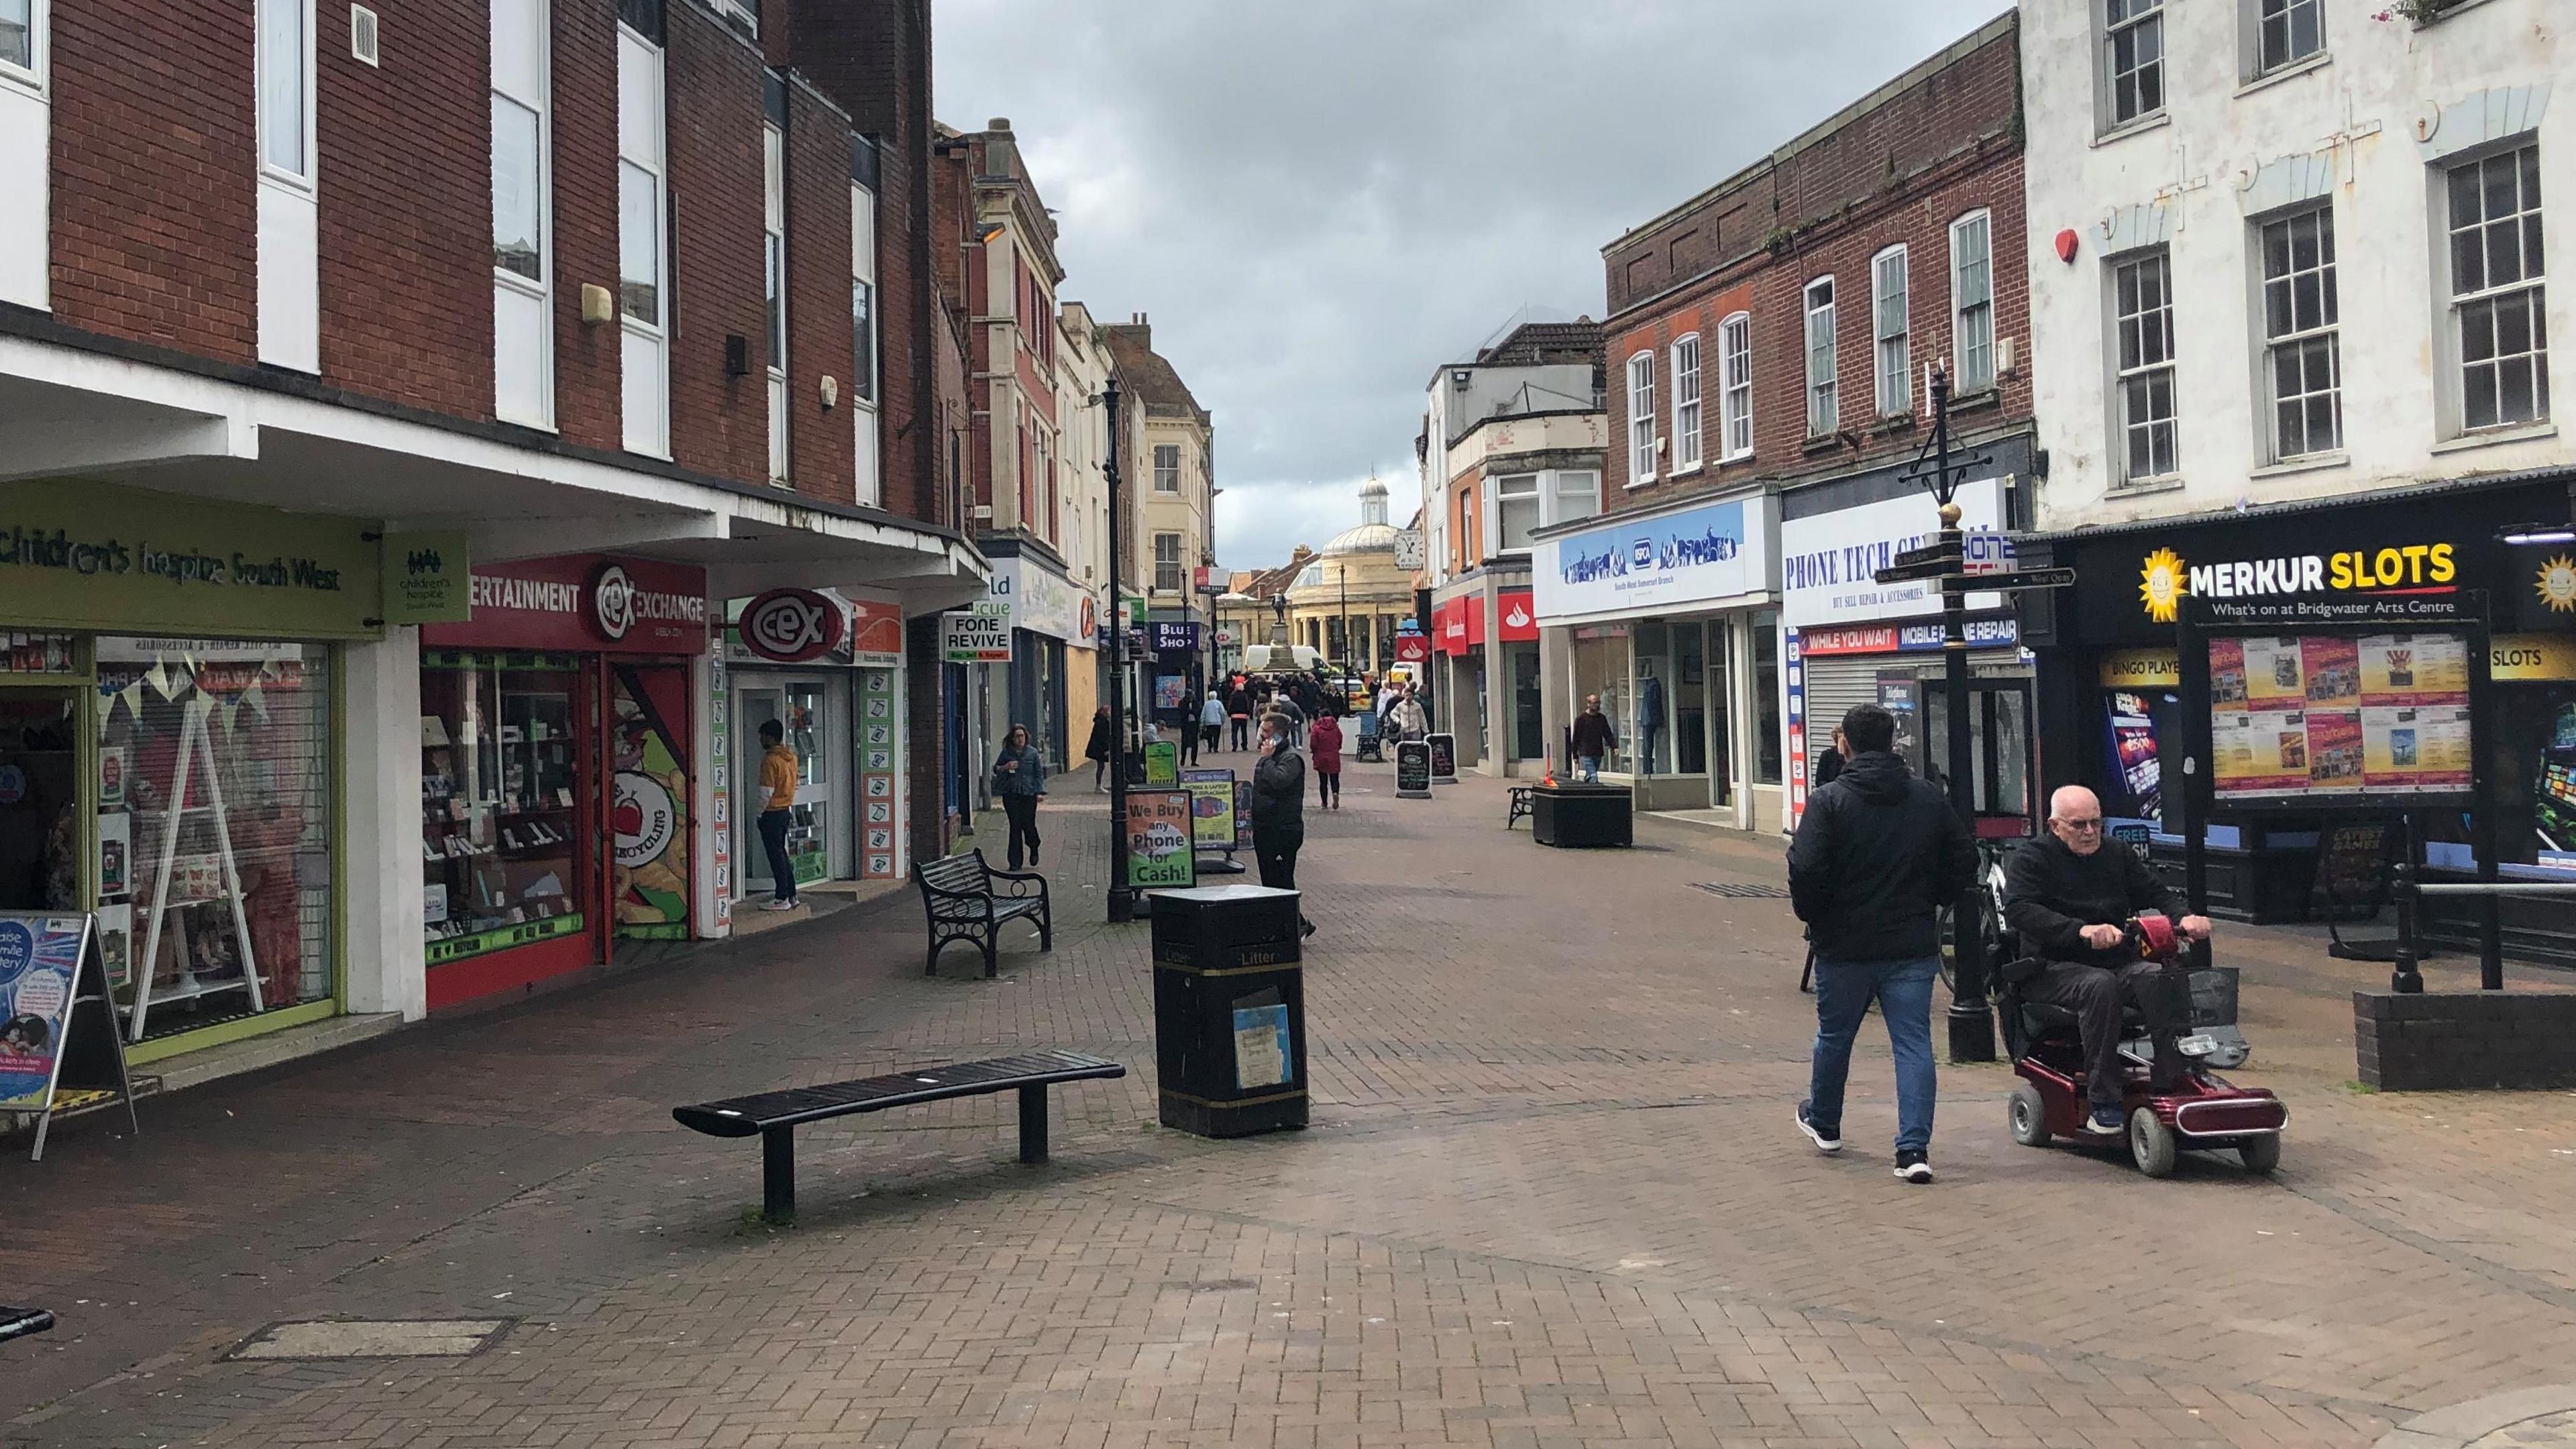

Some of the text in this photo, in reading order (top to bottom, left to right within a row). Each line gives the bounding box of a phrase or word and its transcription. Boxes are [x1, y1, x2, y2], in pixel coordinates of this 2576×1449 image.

[1785, 548, 1839, 590] PHONE
[1843, 540, 1890, 583] TECH
[2189, 542, 2456, 597] MERKUR SLOTS
[990, 576, 1010, 595] ld
[470, 575, 704, 622] ERTAINMENT EXCHANGE
[1845, 594, 1858, 607] SELL
[1859, 592, 1878, 605] REPAIR
[1887, 587, 1923, 604] ACCESSORIES
[2212, 600, 2455, 619] What's on at Bridgwater Arts Centre
[948, 633, 1007, 647] REVIVE
[1809, 629, 1892, 650] WHILE YOU WAIT
[1901, 619, 2017, 645] MOBILE PNE REPAIR
[2492, 649, 2542, 667] SLOTS
[2113, 661, 2145, 675] BINGO
[1130, 804, 1185, 818] We Buy
[1148, 822, 1169, 834] any
[2115, 829, 2147, 840] FREE
[1134, 833, 1185, 847] Phone
[1148, 852, 1169, 863] for
[1136, 864, 1187, 882] Cash!
[1165, 948, 1191, 963] Litter
[1242, 951, 1275, 965] Litter
